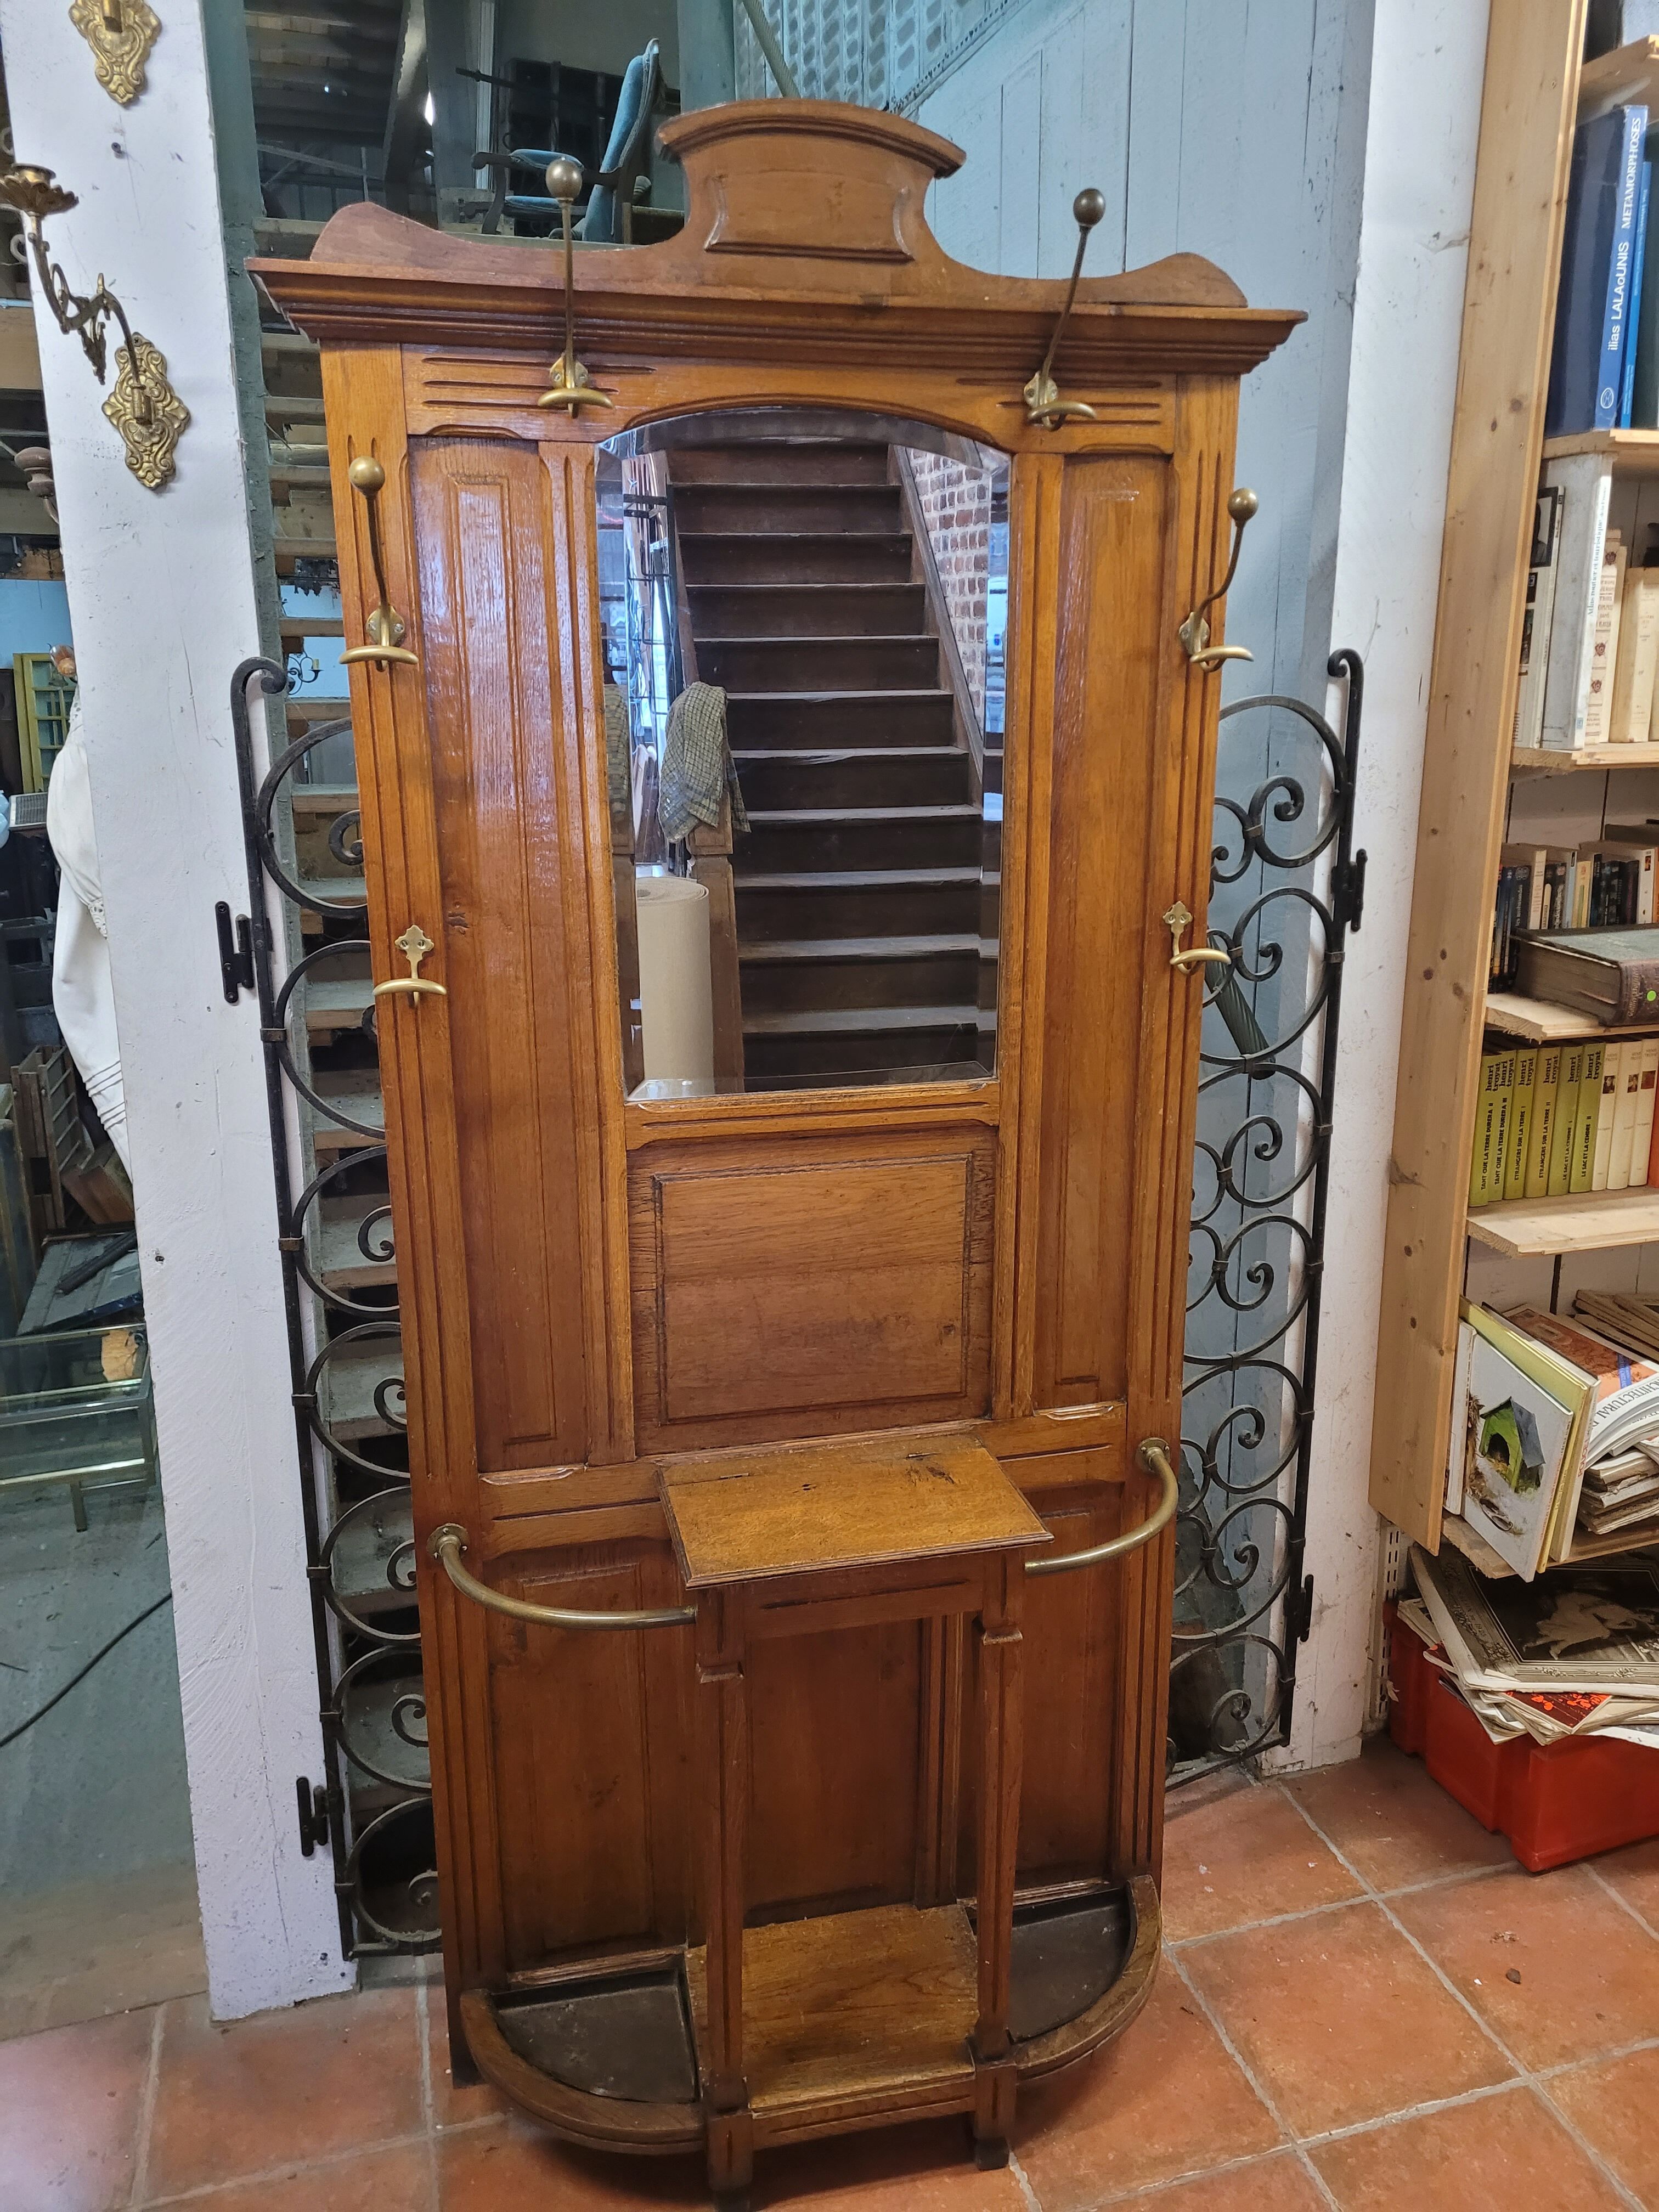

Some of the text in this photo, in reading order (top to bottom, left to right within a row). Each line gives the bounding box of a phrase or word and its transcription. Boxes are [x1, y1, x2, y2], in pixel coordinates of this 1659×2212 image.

[1607, 325, 1620, 351] ilias
[1621, 117, 1641, 229] METAMORPHOSES
[1593, 520, 1604, 562] touristique
[1486, 1065, 1494, 1092] henri
[1492, 1062, 1500, 1092] troyat
[1499, 1060, 1508, 1087] henri
[1519, 1060, 1527, 1086] henri
[1526, 1057, 1534, 1086] troyat
[1543, 1058, 1552, 1084] henri
[1550, 1054, 1559, 1084] troyat
[1568, 1056, 1576, 1082] henri
[1585, 1053, 1594, 1079] henri
[1484, 1152, 1489, 1160] LA
[1497, 1147, 1503, 1155] LA
[1565, 1147, 1570, 1155] LA
